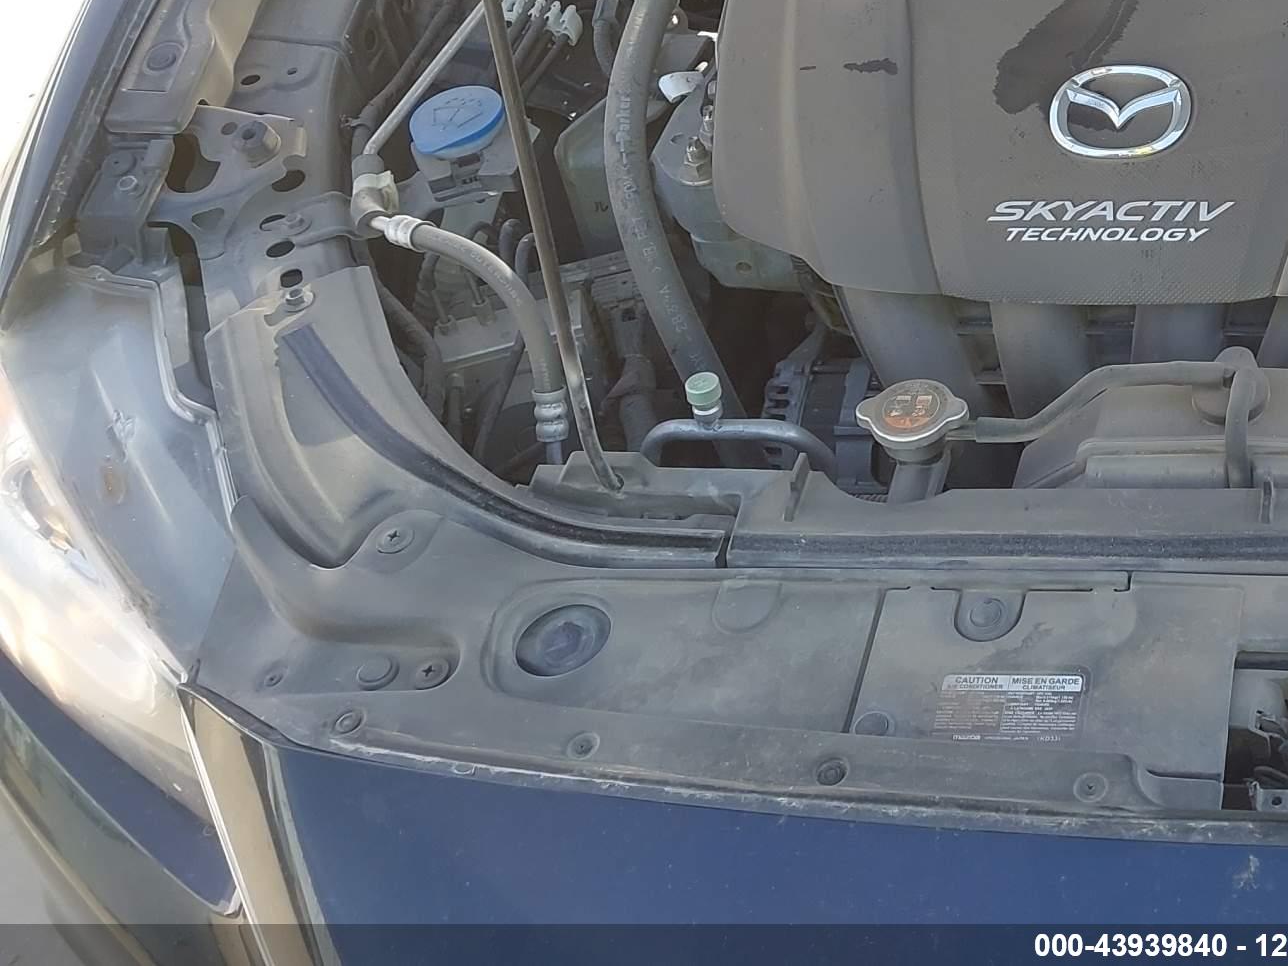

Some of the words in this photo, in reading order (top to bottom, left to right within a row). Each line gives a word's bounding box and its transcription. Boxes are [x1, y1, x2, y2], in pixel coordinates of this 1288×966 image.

[986, 200, 1236, 222] SKYACTIV
[1006, 227, 1210, 242] TECHNOLOGY
[955, 676, 999, 684] CAUTION
[1048, 677, 1080, 685] GARDE
